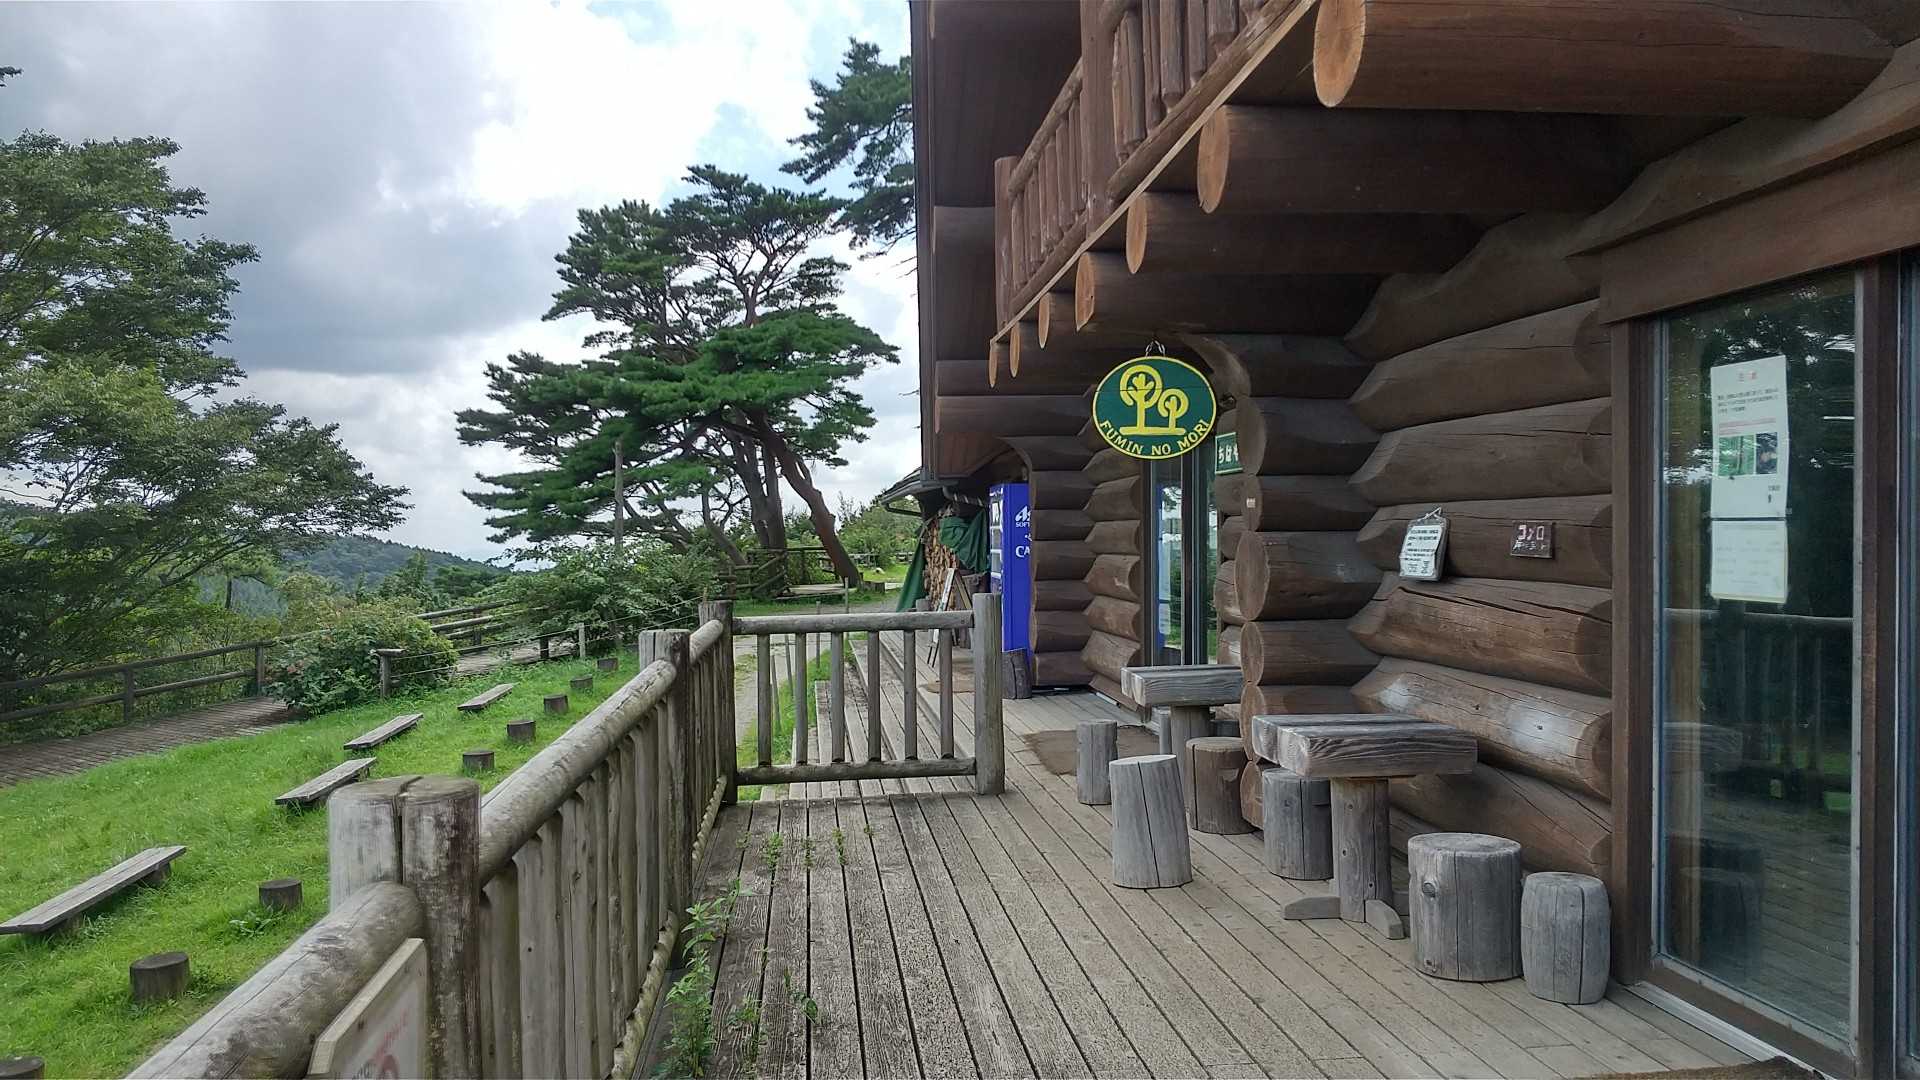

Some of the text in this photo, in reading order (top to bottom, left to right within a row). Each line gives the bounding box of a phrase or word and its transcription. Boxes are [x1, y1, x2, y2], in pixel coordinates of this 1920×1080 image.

[1100, 419, 1210, 456] FUMIN NO MORI
